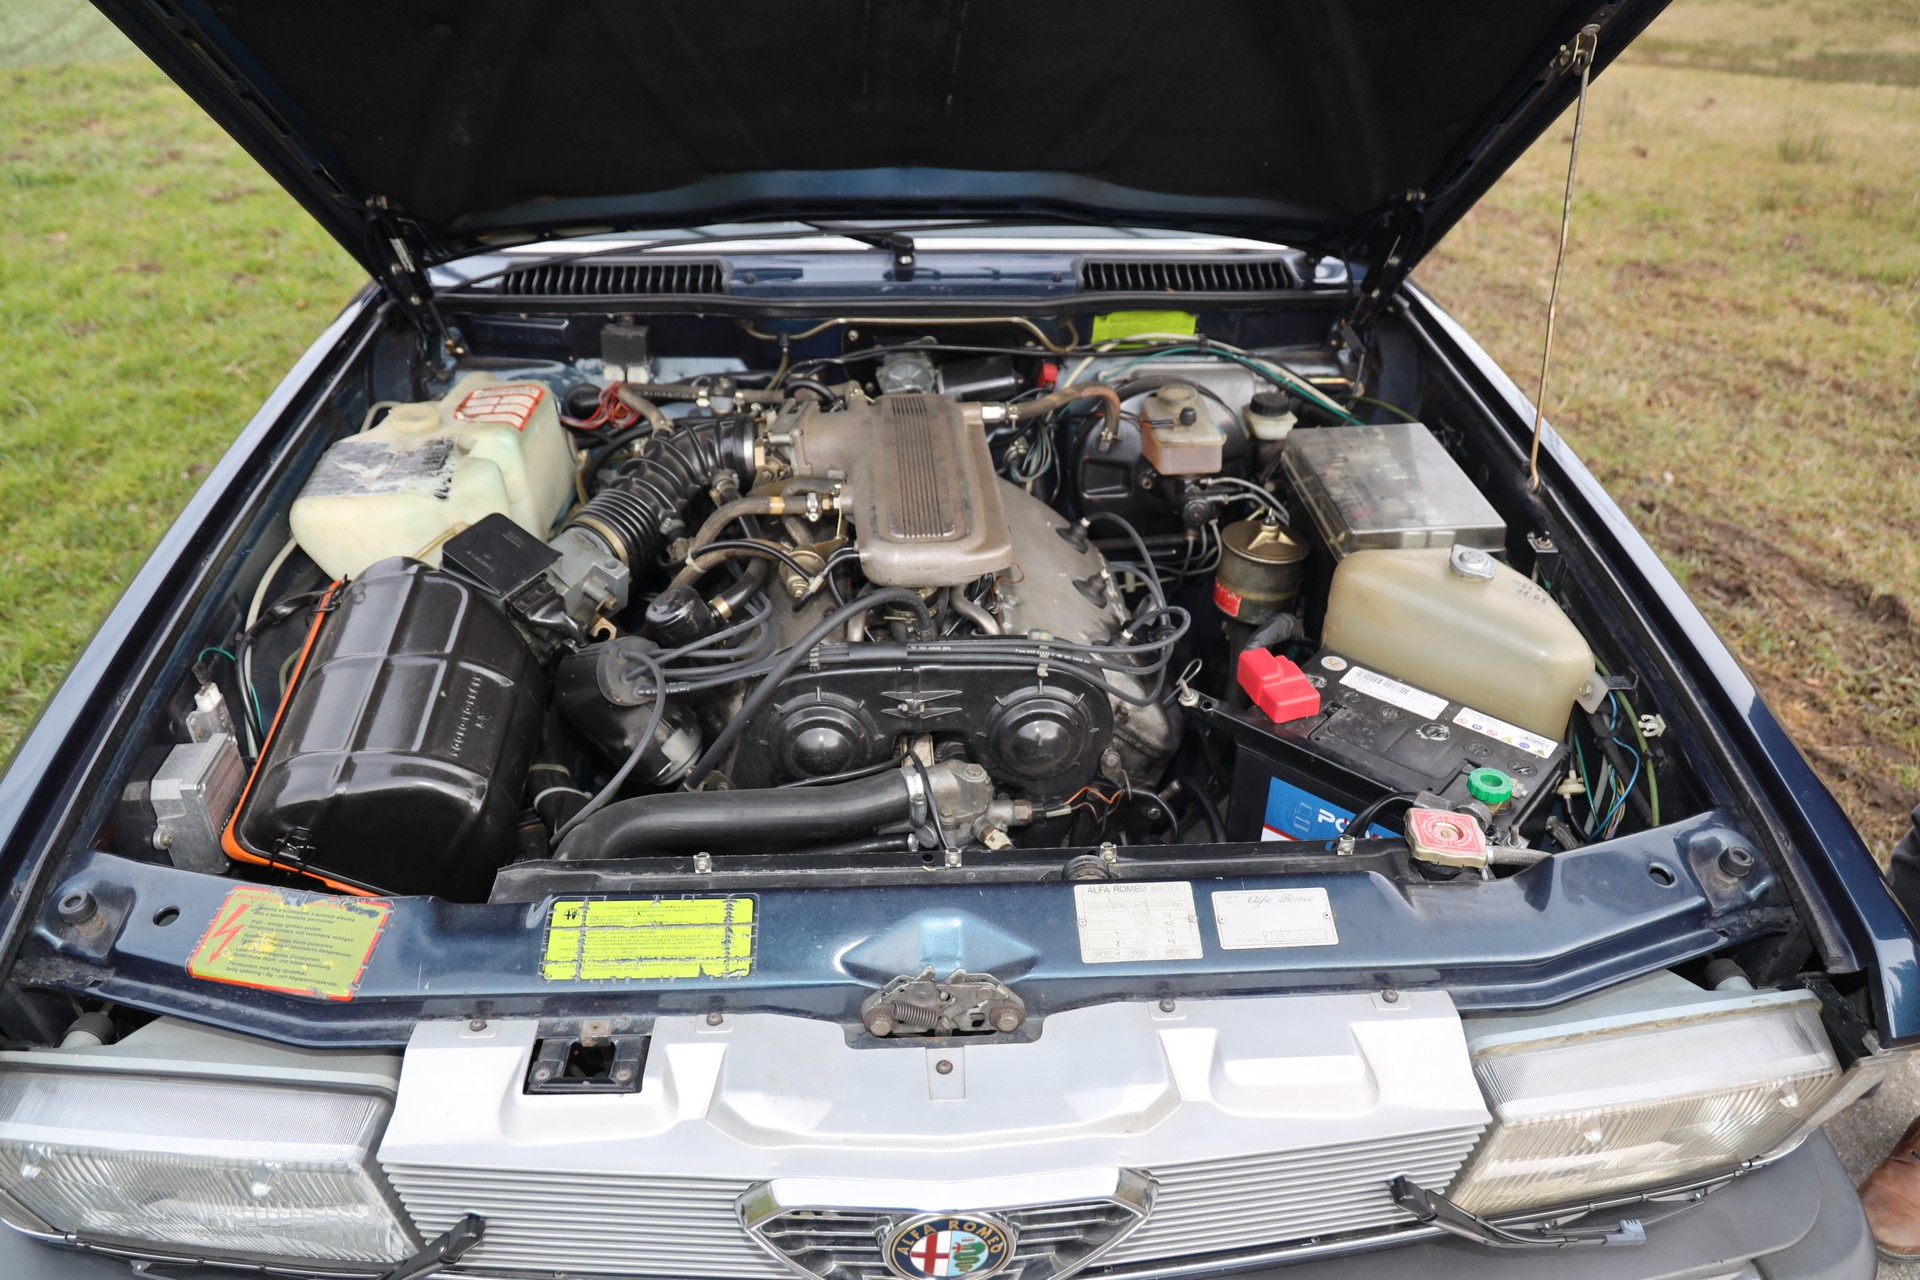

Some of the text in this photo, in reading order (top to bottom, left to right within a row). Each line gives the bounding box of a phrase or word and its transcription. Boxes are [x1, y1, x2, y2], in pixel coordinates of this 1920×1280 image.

[1087, 885, 1110, 894] ALFA
[1113, 884, 1148, 893] ROMEO
[896, 1220, 1004, 1256] ALFA ROMEO
